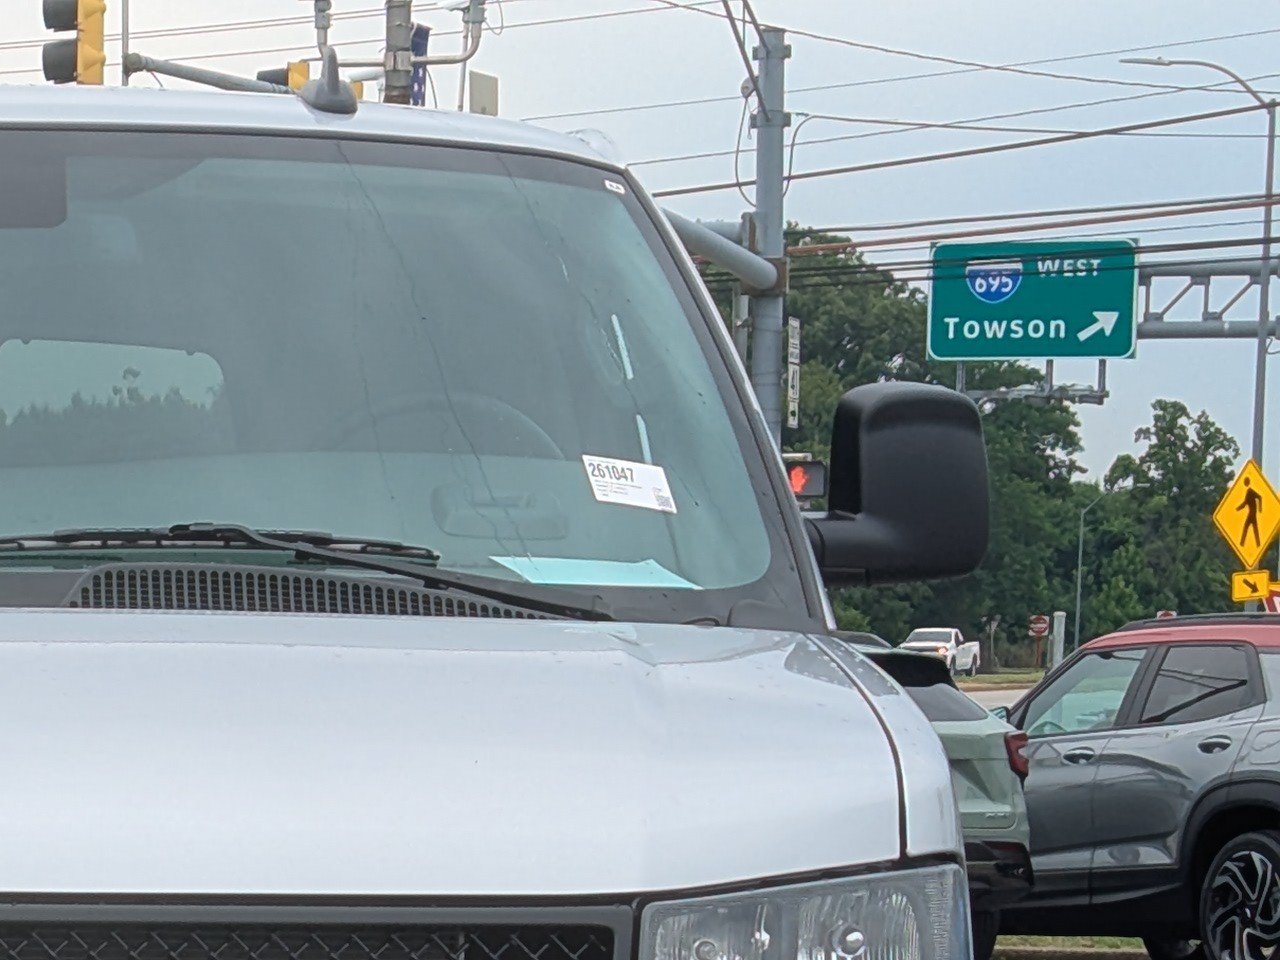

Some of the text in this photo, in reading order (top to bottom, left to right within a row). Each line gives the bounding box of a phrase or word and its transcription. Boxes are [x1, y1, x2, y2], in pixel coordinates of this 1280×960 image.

[974, 257, 1101, 293] 695 WEST
[943, 316, 1066, 340] Towson
[588, 462, 635, 482] 261047
